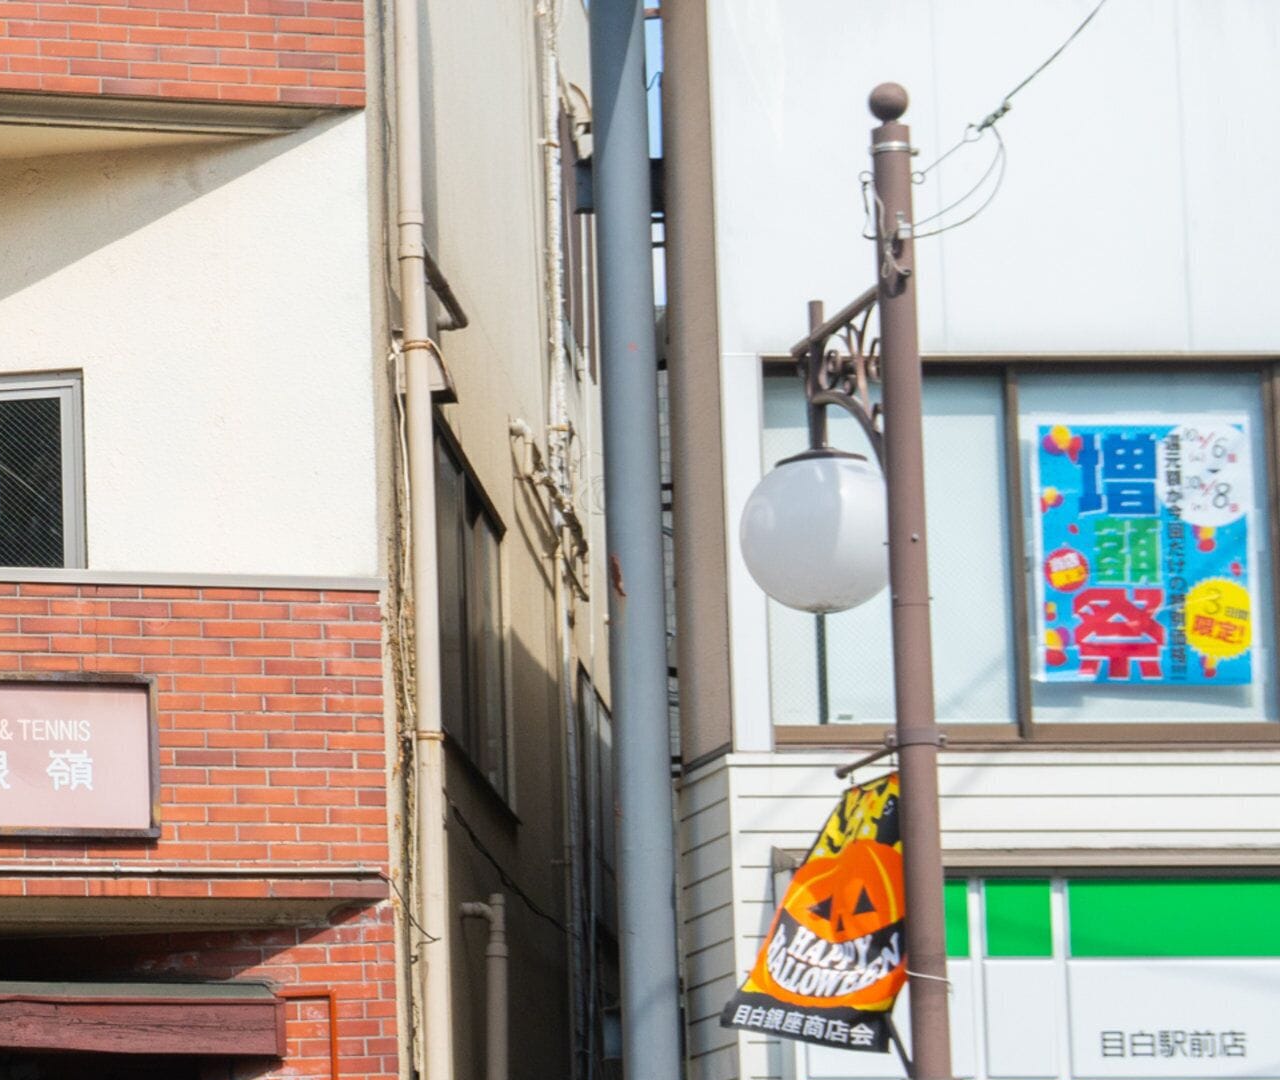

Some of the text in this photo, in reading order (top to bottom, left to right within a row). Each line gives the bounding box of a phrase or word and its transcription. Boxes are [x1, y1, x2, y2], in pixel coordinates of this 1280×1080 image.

[0, 719, 14, 741] &
[17, 719, 91, 742] TENNIS
[766, 923, 900, 997] HALLOWEEN
[786, 925, 873, 971] HAPPY
[732, 1004, 875, 1046] 目白銀座商店会
[1100, 1030, 1247, 1057] 目白駅前店
